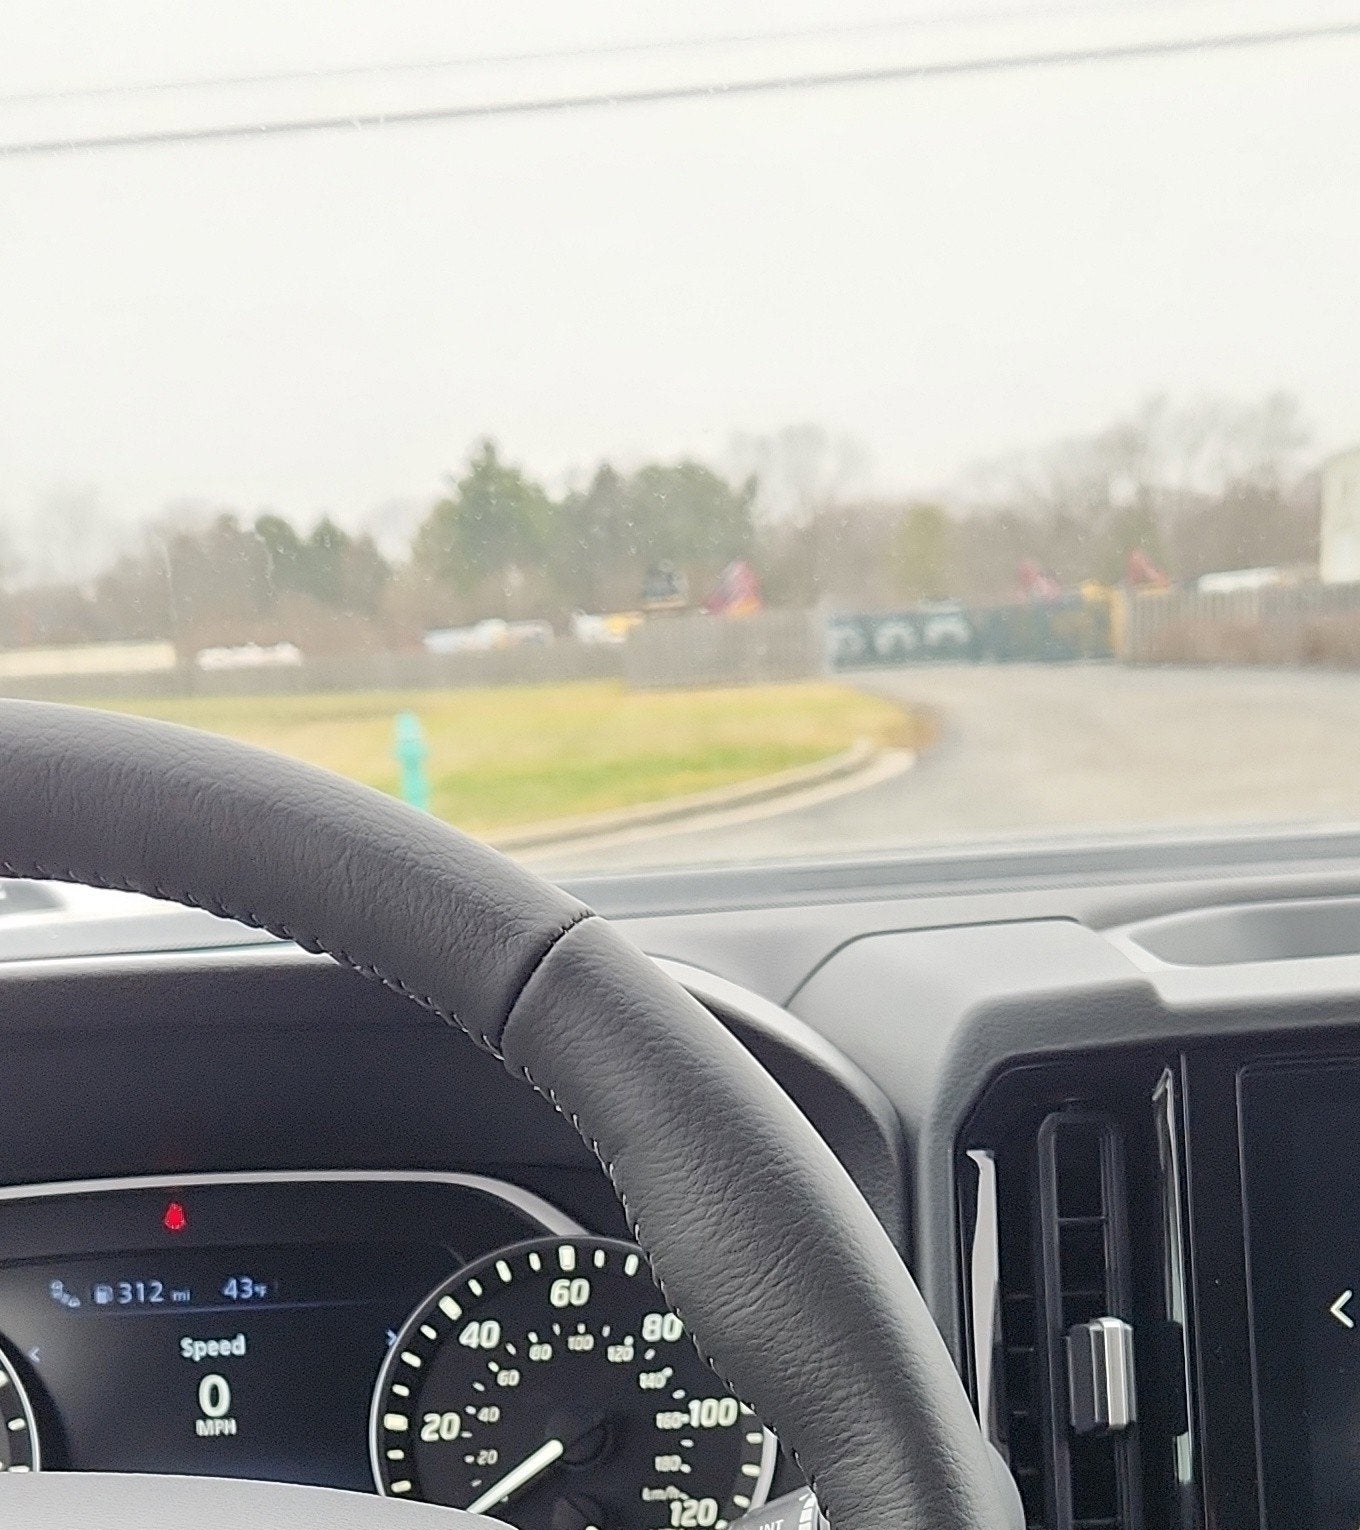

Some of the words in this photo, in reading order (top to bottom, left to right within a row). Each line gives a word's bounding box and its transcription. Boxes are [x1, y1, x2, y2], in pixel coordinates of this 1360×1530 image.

[119, 1280, 165, 1304] 312
[173, 1289, 191, 1302] mi
[550, 1278, 590, 1308] 60
[459, 1320, 501, 1349] 40
[643, 1313, 683, 1342] 80
[180, 1333, 246, 1361] Speed
[198, 1374, 231, 1418] 0
[421, 1412, 461, 1442] 20
[478, 1406, 500, 1423] 40
[688, 1398, 738, 1428] 100
[195, 1419, 237, 1437] MPH
[478, 1450, 498, 1465] 20
[671, 1498, 718, 1528] 120
